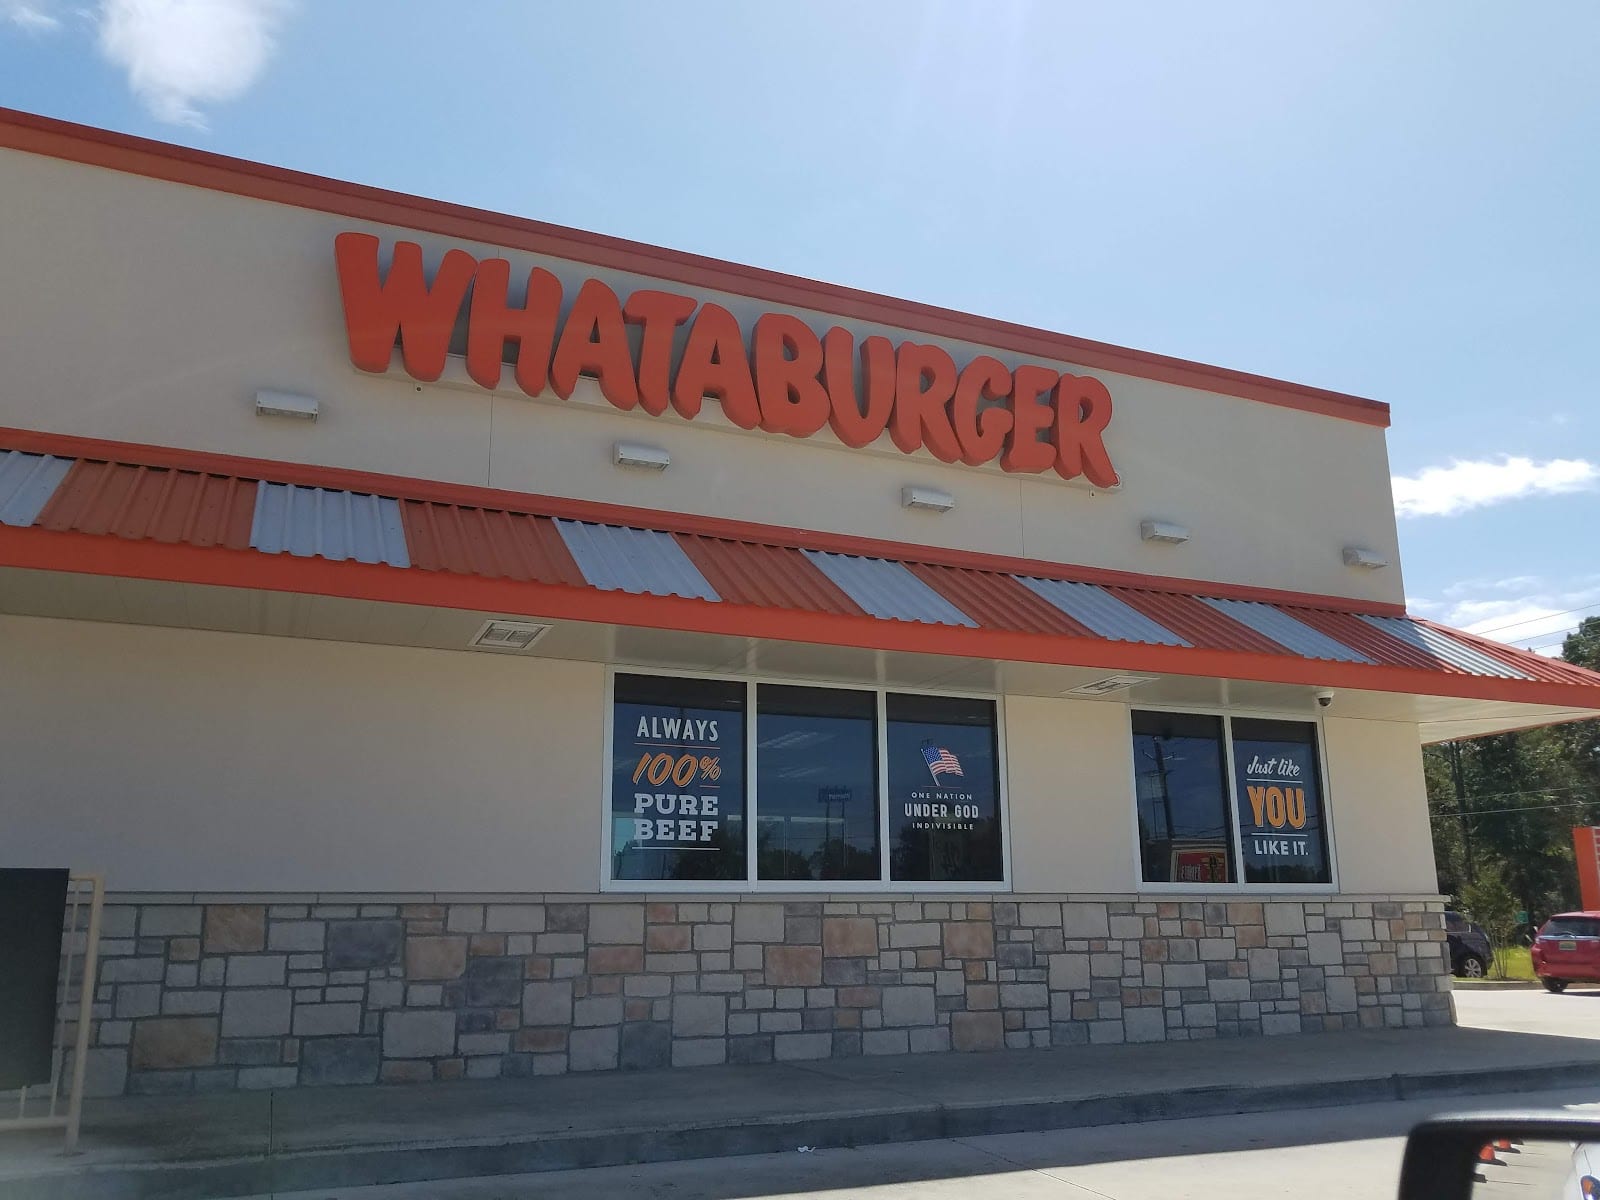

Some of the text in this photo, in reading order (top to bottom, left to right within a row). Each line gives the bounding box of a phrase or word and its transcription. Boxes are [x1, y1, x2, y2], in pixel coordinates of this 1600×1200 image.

[335, 232, 1119, 488] WHATABURGER
[637, 715, 719, 741] ALWAYS
[633, 752, 721, 787] 100%
[1247, 755, 1300, 776] Just like
[634, 793, 718, 816] PURE
[904, 803, 979, 819] UNDER GOD
[1247, 786, 1306, 829] YOU
[634, 819, 718, 841] BEEF
[912, 822, 974, 831] INDIVISIBLE
[1254, 840, 1309, 856] LIKE IT.
